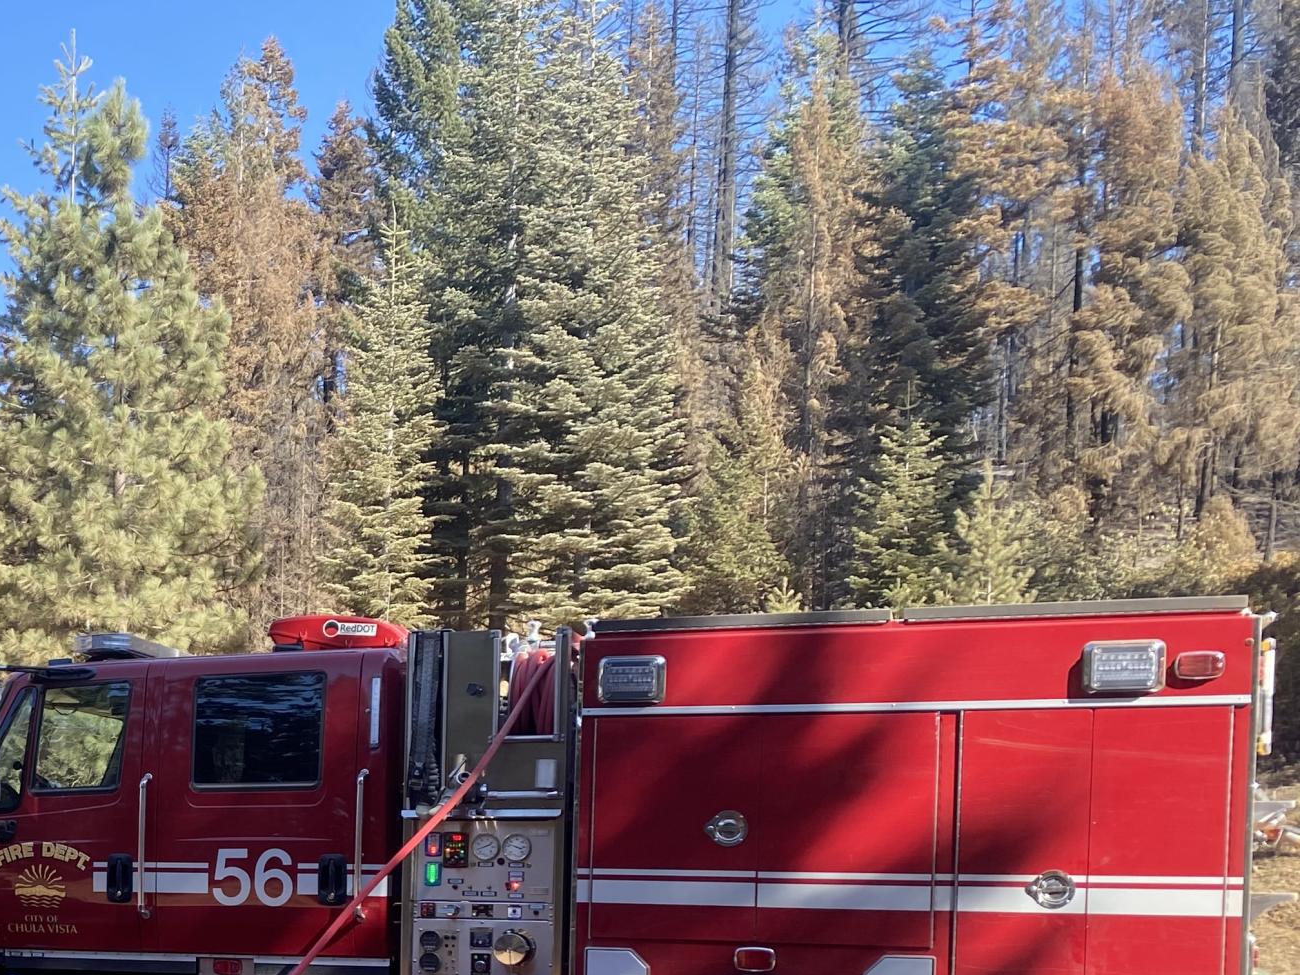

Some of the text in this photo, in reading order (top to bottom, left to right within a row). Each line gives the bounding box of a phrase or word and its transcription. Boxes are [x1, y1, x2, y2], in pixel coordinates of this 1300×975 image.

[340, 624, 375, 633] RedDOT
[212, 847, 294, 907] 56
[24, 914, 58, 923] CITY OF
[7, 923, 78, 934] CHULA VISTA
